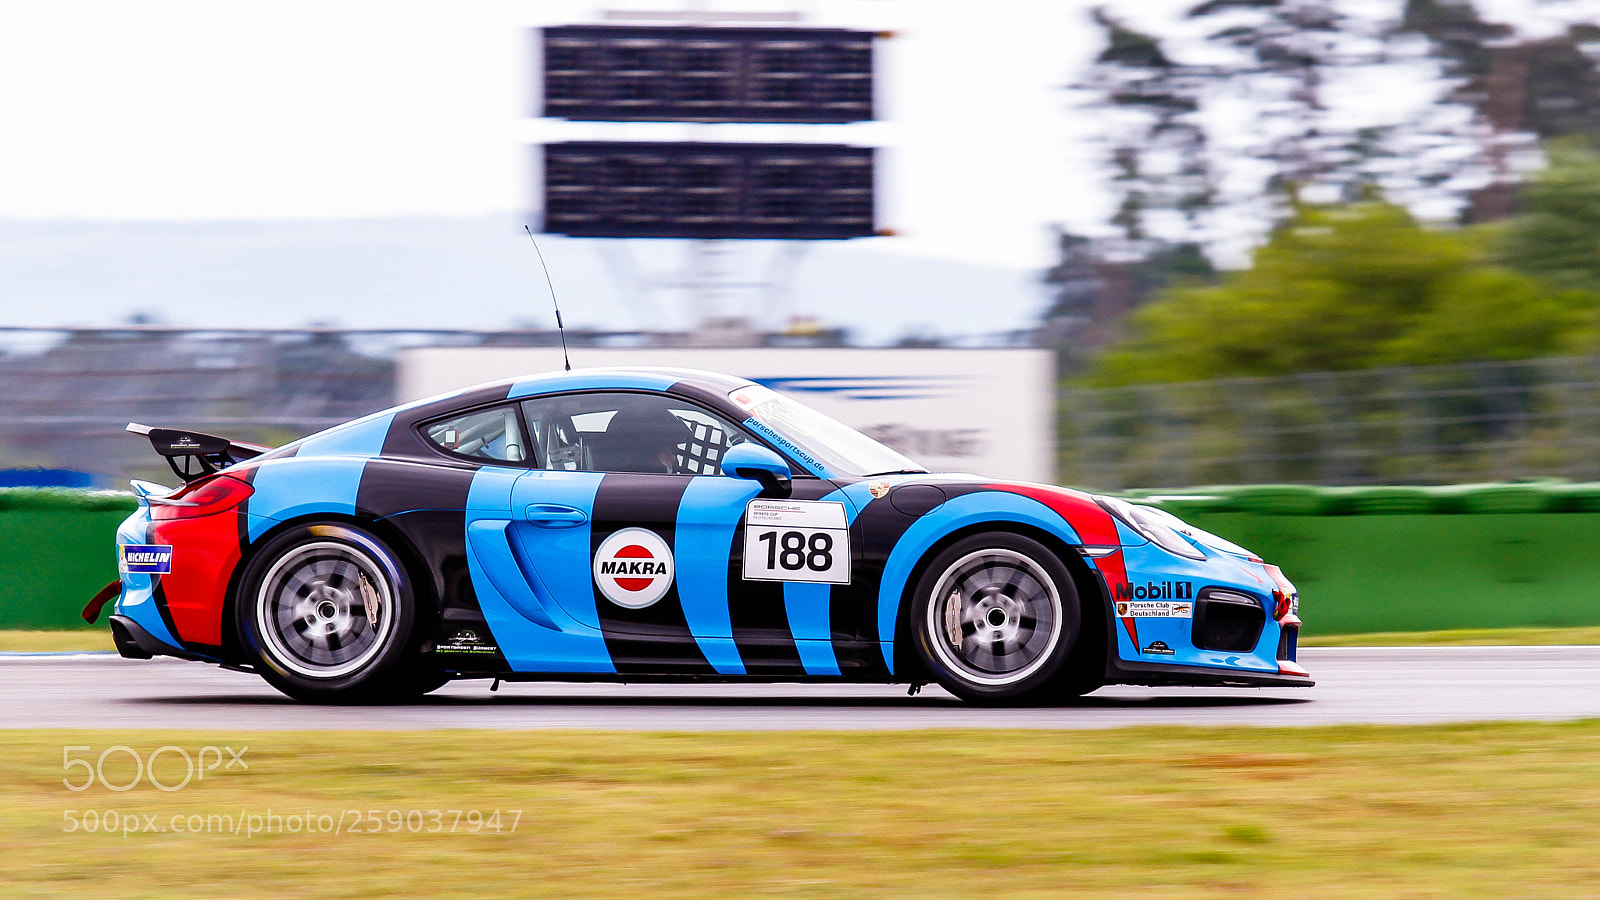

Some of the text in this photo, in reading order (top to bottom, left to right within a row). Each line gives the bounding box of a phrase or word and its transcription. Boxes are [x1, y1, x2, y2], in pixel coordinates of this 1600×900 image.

[746, 417, 825, 471] porschesportscup.de
[127, 552, 171, 563] MICHELIN
[759, 531, 833, 572] 188
[600, 561, 667, 575] MAKRA
[1116, 581, 1172, 599] Mobil
